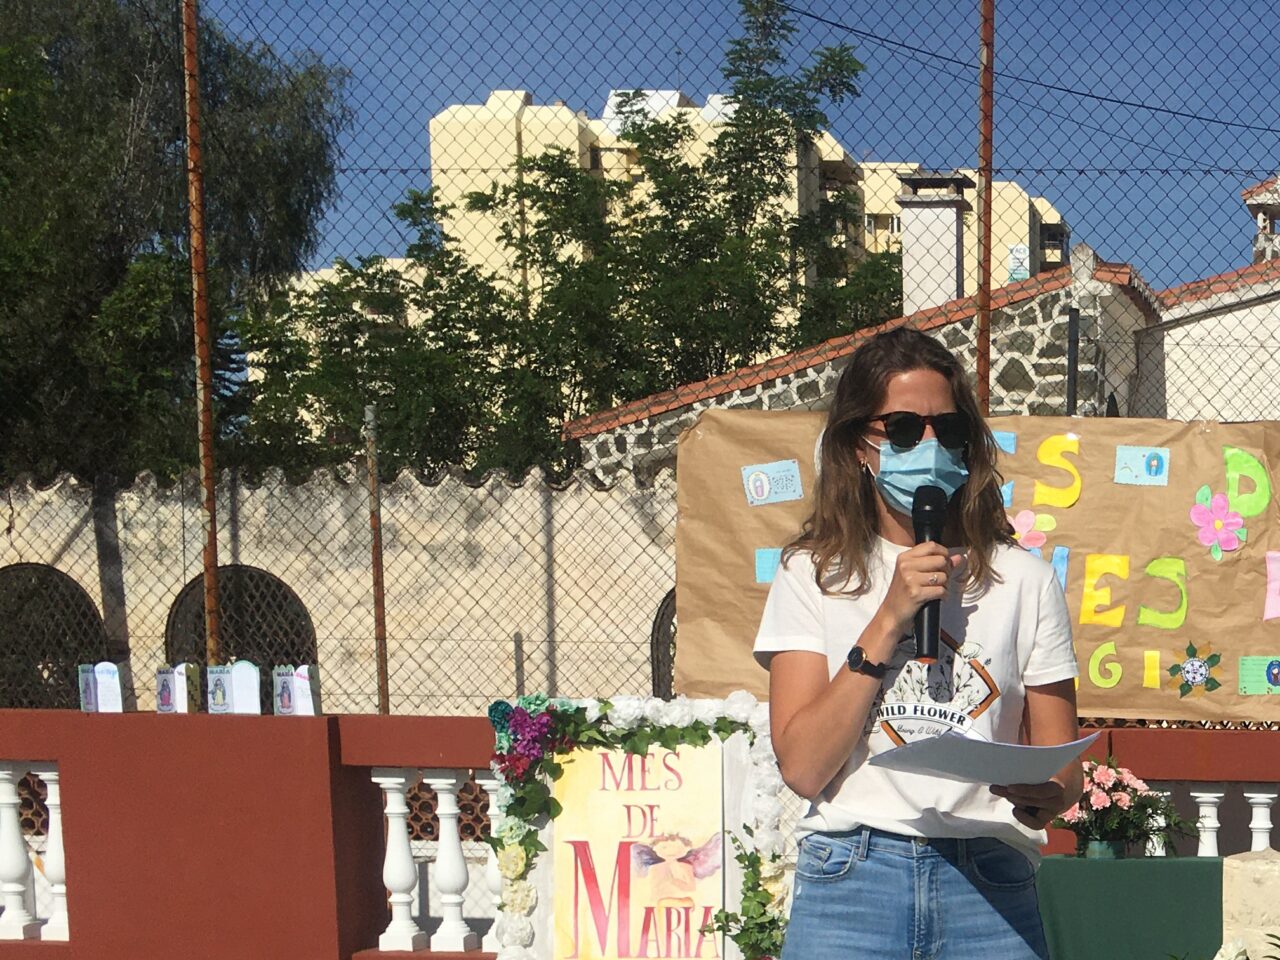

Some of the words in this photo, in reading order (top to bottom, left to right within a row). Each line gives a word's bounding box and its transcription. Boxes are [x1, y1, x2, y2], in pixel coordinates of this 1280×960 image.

[913, 705, 967, 727] FLOWER
[599, 751, 684, 792] MES
[622, 804, 665, 839] DE
